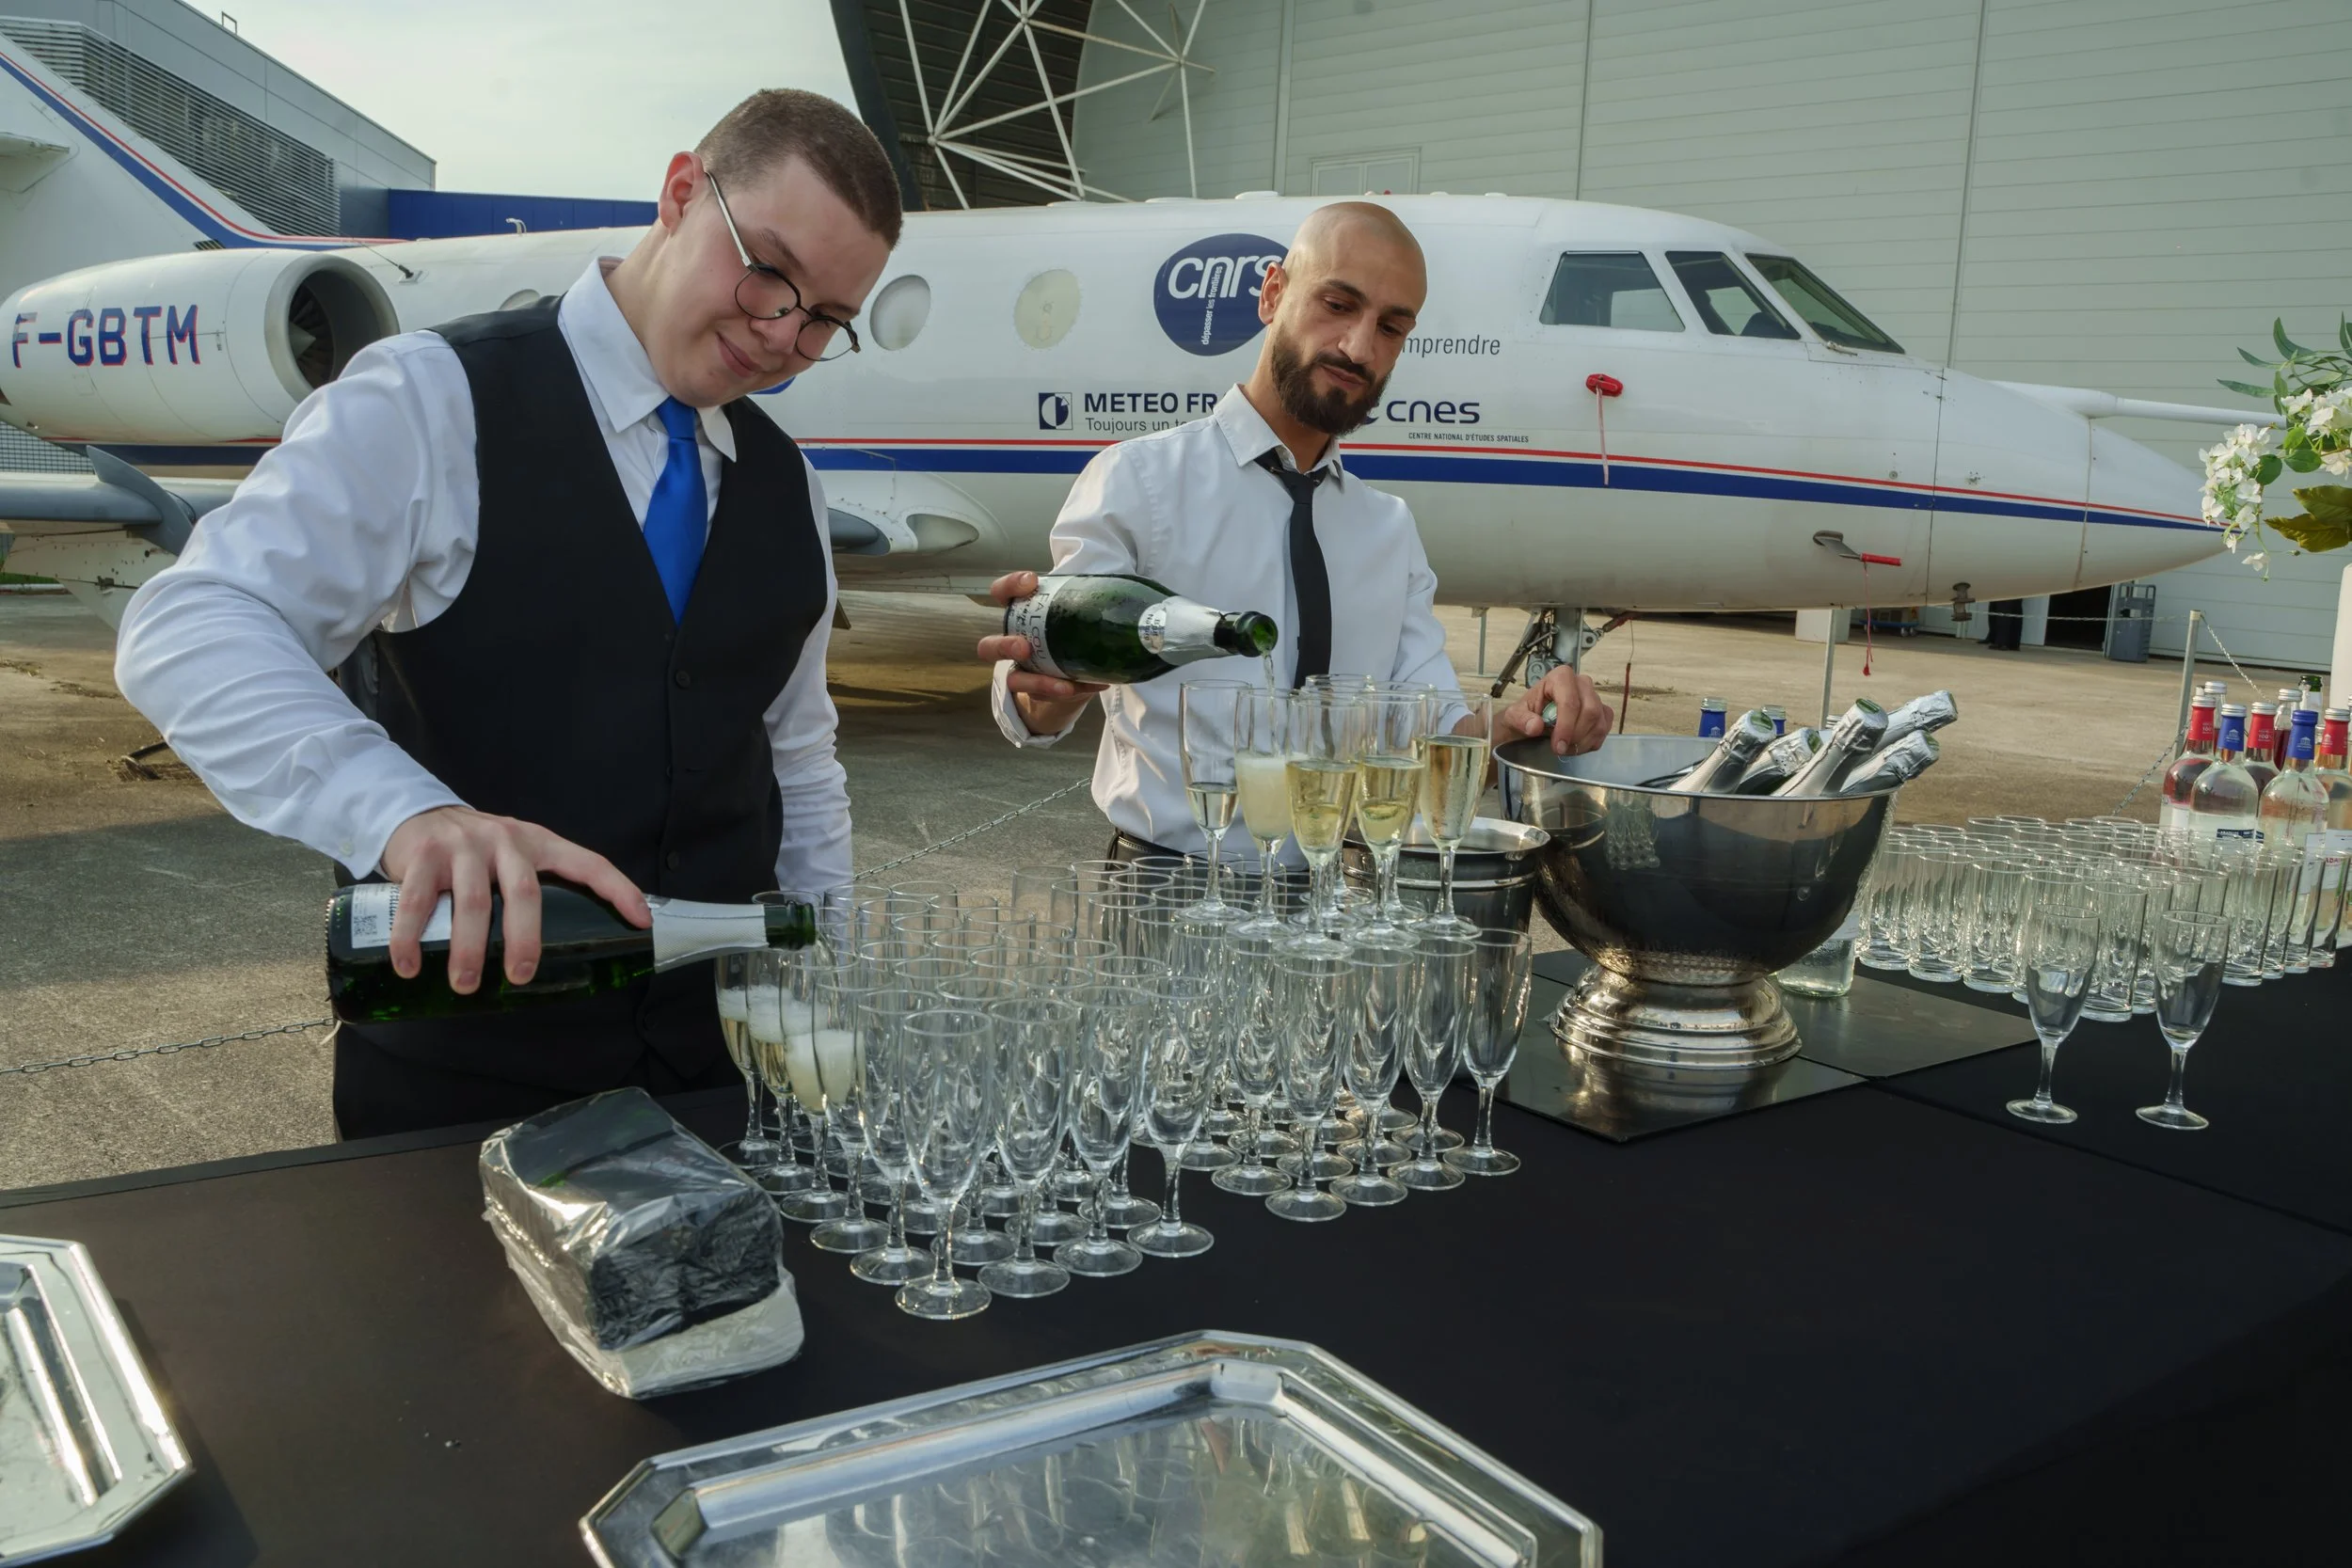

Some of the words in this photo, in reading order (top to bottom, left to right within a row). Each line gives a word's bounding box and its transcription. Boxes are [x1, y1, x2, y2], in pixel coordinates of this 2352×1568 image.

[1168, 255, 1282, 299] cnrs
[1208, 265, 1223, 298] frontières
[1206, 298, 1216, 309] les
[12, 304, 201, 369] F-GBTM
[1200, 309, 1214, 345] dépasser
[1084, 392, 1179, 414] METEO
[1386, 400, 1481, 424] cnes
[1085, 418, 1147, 435] Toujours
[1152, 421, 1169, 431] un
[1407, 432, 1432, 440] CENTRE
[1434, 433, 1464, 441] NATIONAL
[1465, 433, 1495, 442] D'ÉTUDES
[1497, 435, 1529, 443] SPATIALES
